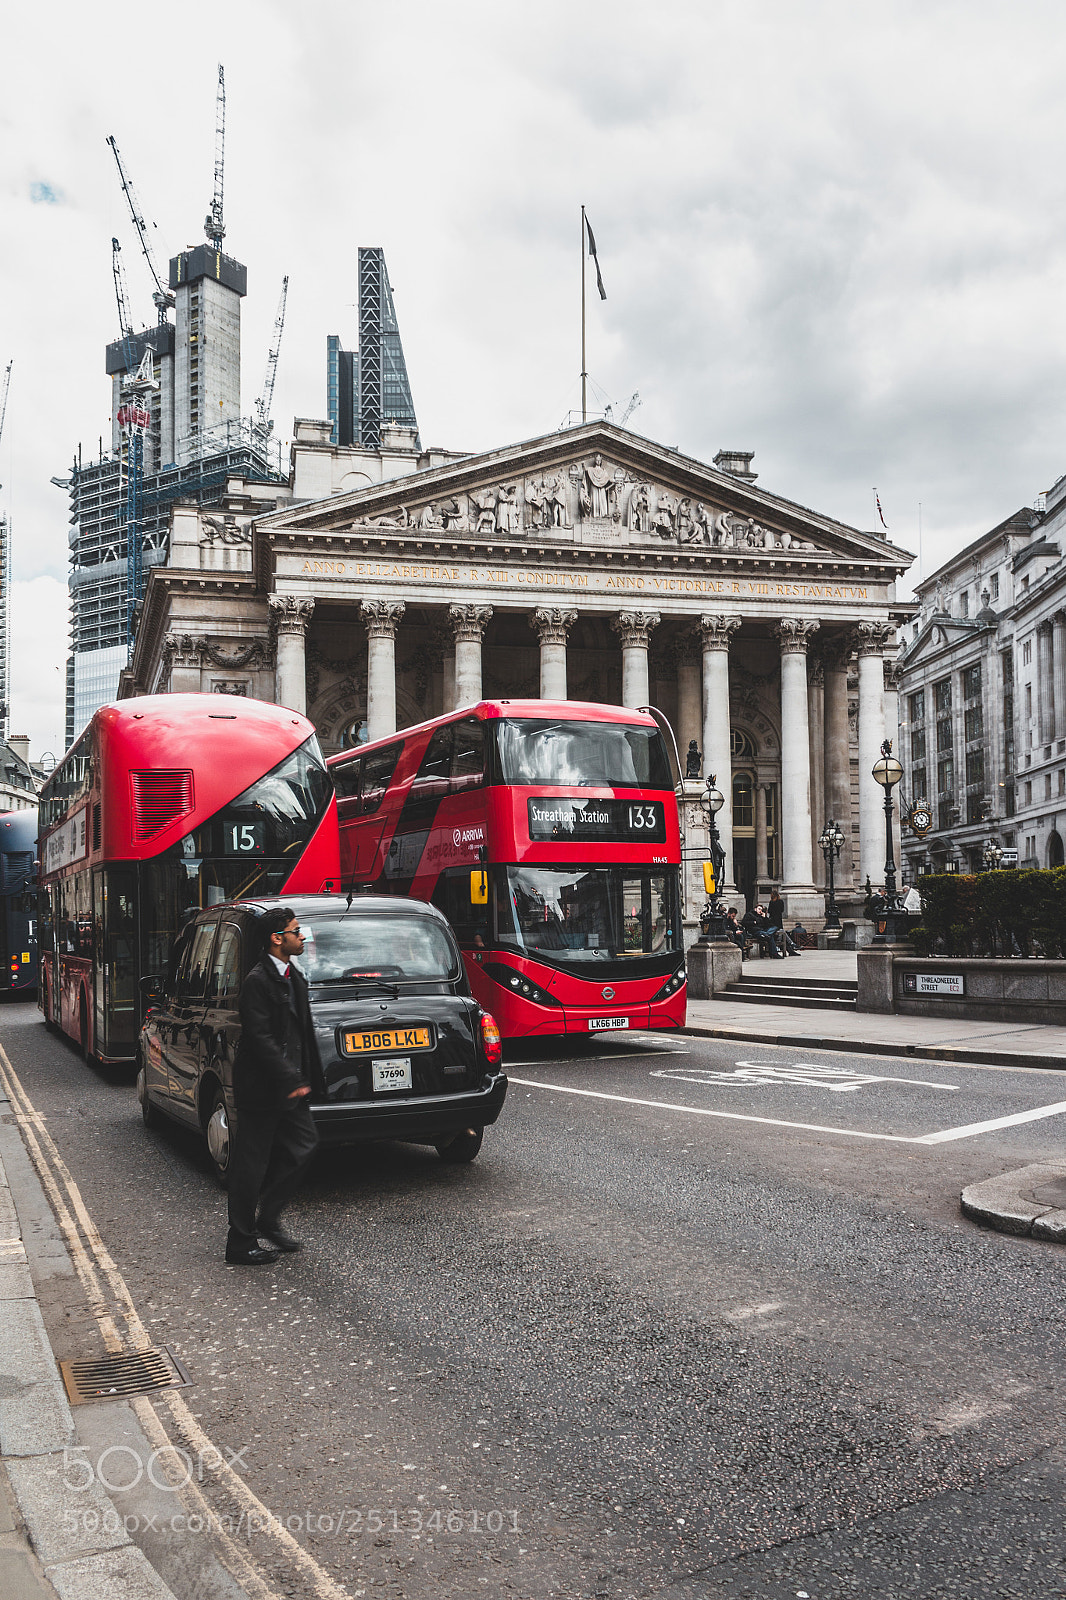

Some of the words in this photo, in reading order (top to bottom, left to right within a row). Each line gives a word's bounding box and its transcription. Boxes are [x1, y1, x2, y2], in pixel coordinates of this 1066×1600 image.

[302, 561, 346, 574] ANNO
[356, 563, 460, 580] ELIZABETHAE
[469, 569, 479, 581] R
[486, 570, 509, 582] XIII
[516, 572, 588, 586] CONDITVM
[605, 576, 645, 589] ANNO
[653, 578, 724, 593] VICTORIAE
[731, 582, 741, 593] R
[748, 583, 768, 595] VIII
[775, 583, 868, 599] RESTAVRATVM
[532, 805, 576, 822] Streatham
[580, 809, 609, 824] Station
[628, 805, 656, 829] 133
[232, 825, 255, 851] 15
[461, 828, 484, 842] ARRIVA
[652, 856, 668, 864] HA45
[921, 977, 959, 985] THREADNEEDLE
[591, 1020, 610, 1029] LK66
[611, 1018, 626, 1027] HBP
[395, 1031, 424, 1046] LKL
[380, 1070, 405, 1079] 37690
